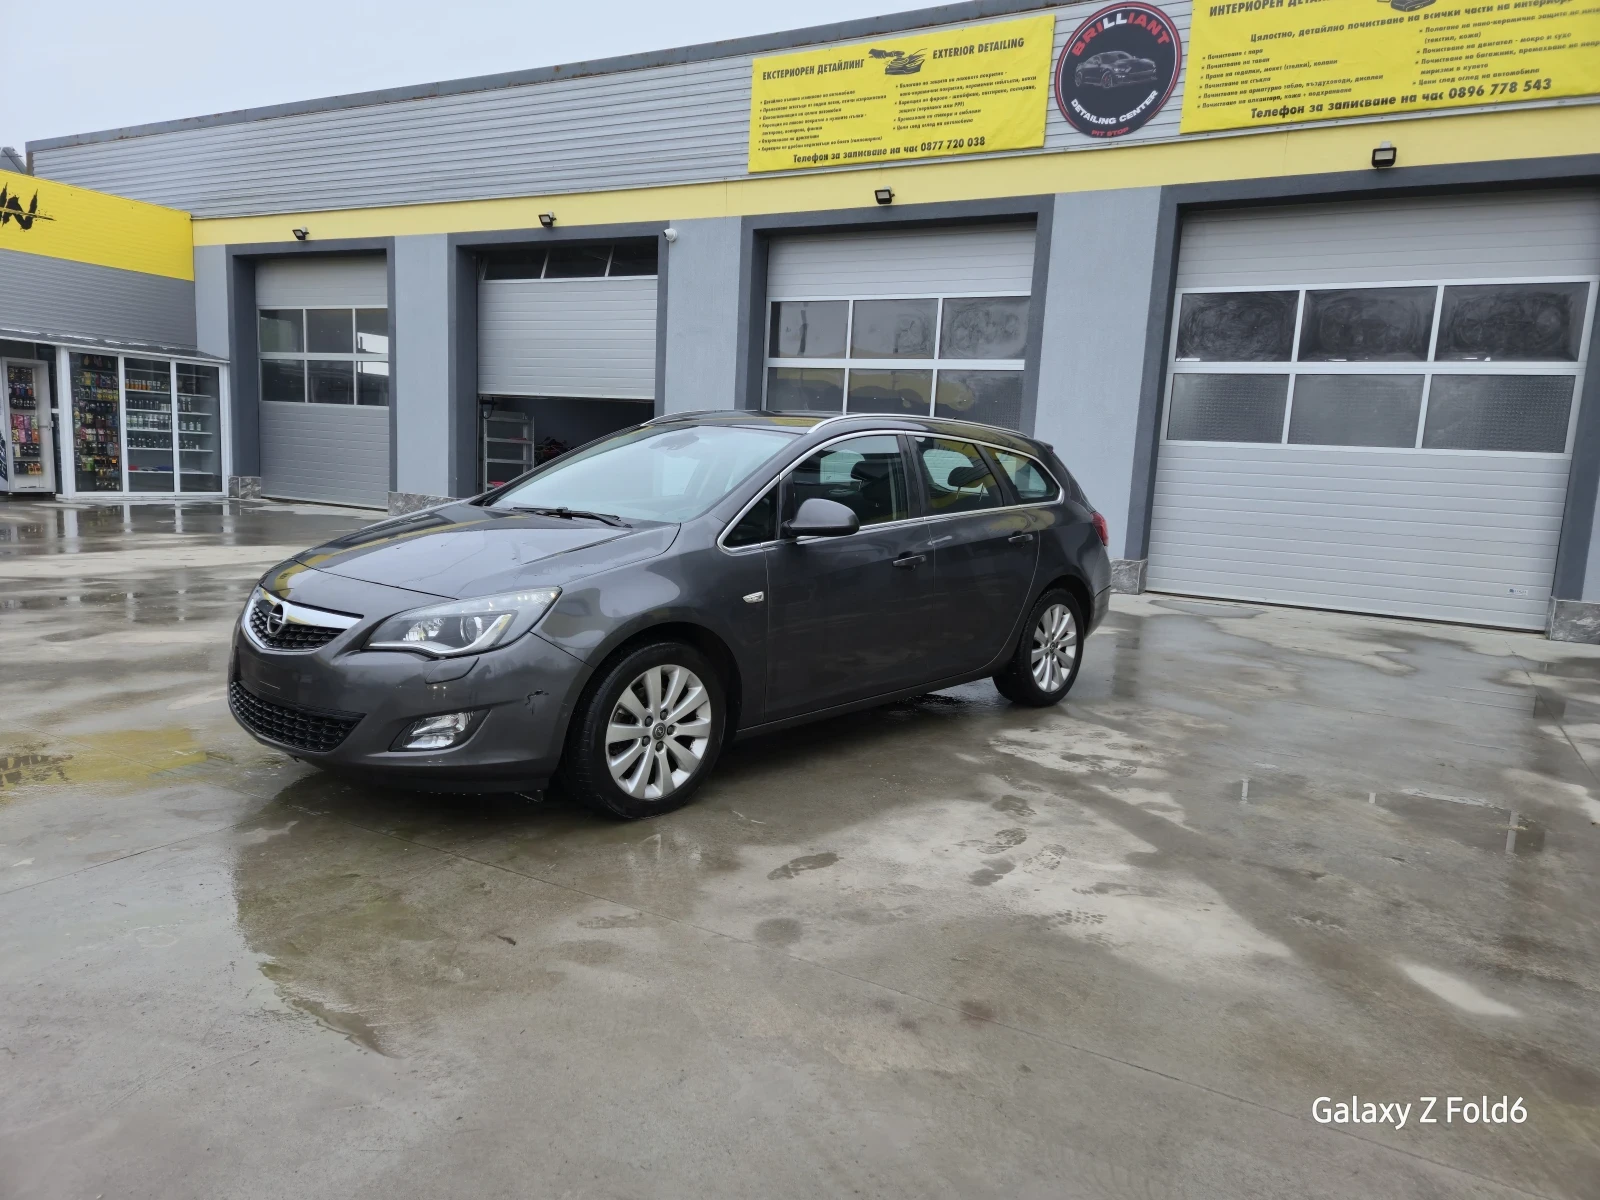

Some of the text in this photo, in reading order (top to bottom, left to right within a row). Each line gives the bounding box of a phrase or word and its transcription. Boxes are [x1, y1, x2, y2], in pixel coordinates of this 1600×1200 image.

[1210, 0, 1283, 17] ИНТЕРИОРЕН
[1071, 12, 1170, 56] BRILLIANT
[1250, 31, 1295, 43] Цялостно,
[1298, 25, 1344, 37] детайлно
[1348, 17, 1404, 30] почистване
[1424, 10, 1460, 20] всички
[1465, 6, 1493, 14] части
[1497, 3, 1510, 11] на
[932, 37, 1024, 59] EXTERIOR DETAILING
[763, 59, 864, 80] ЕКСТЕРИОРЕН ДЕТАЙЛИНГ
[1071, 90, 1159, 125] DETAILING CENTER
[1251, 78, 1551, 118] Телефон за записване на час 0896 778 543
[1106, 127, 1129, 137] STOP
[793, 153, 828, 164] Телефон
[843, 148, 887, 159] записване
[904, 145, 918, 153] час
[921, 140, 944, 152] 0877
[947, 138, 964, 150] 720
[968, 136, 985, 147] 038
